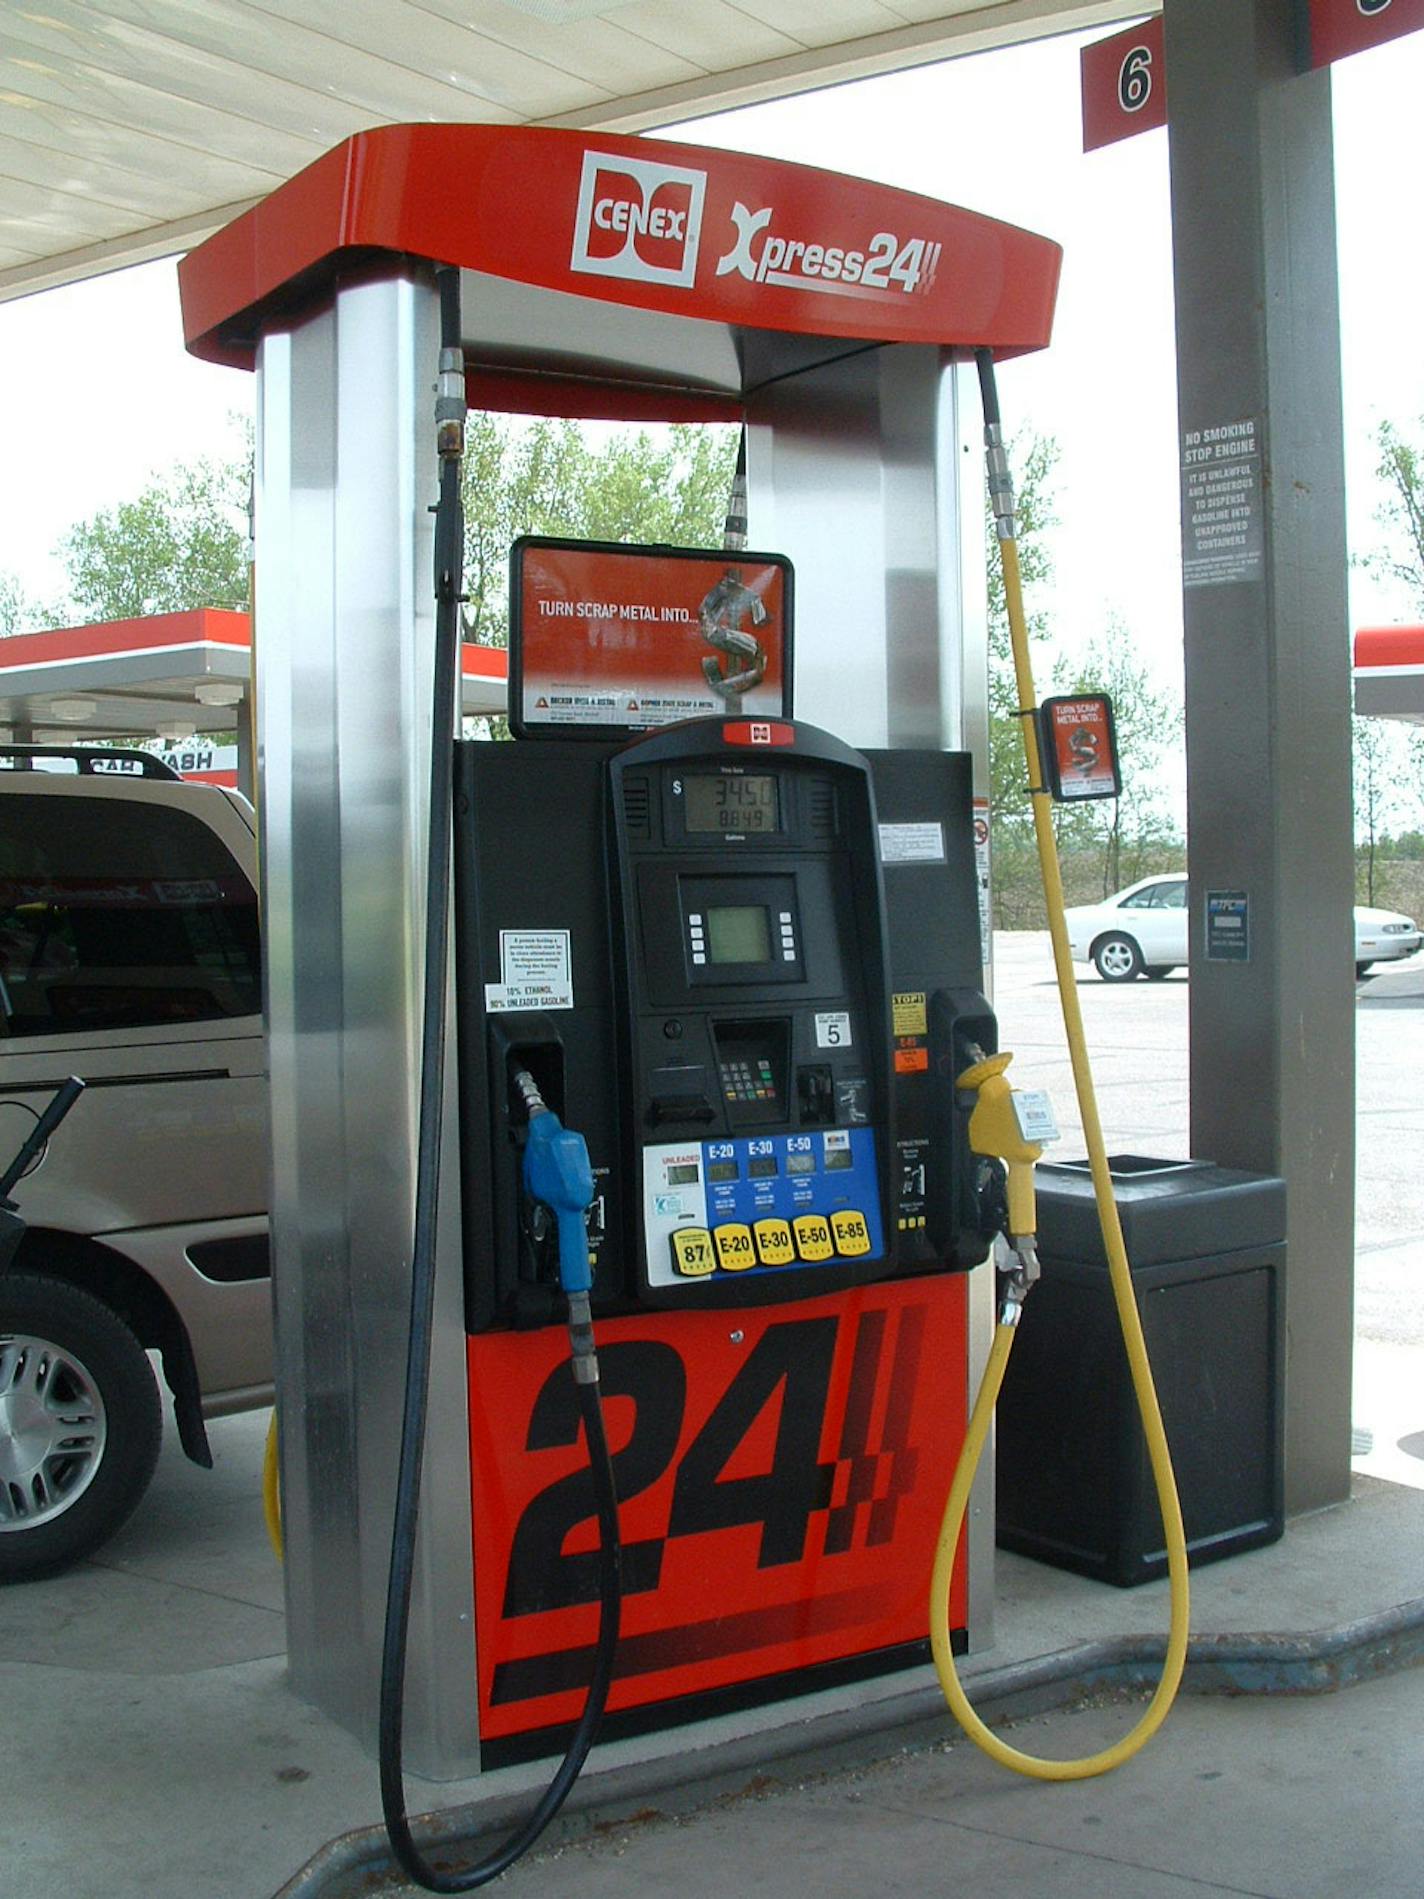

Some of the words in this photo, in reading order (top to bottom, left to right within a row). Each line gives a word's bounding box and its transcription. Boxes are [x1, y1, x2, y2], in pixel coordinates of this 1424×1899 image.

[1118, 46, 1152, 112] 6
[595, 198, 687, 241] CENEX
[1186, 432, 1200, 446] NO
[1203, 422, 1254, 442] SMOKING
[1184, 447, 1212, 463] STOP
[1215, 439, 1255, 458] ENGINE
[1208, 464, 1251, 482] UNLAWFUL
[1206, 478, 1254, 495] DANGEROUS
[539, 600, 574, 617] TURN
[576, 602, 618, 619] SCRAP
[620, 604, 659, 622] METAL
[661, 608, 699, 624] INTO...
[673, 780, 682, 795] $
[828, 1024, 840, 1045] 5
[708, 1144, 734, 1159] E-20
[748, 1140, 773, 1155] E-30
[787, 1137, 811, 1152] E-50
[662, 1155, 700, 1165] UNLEADED
[759, 1231, 788, 1249] E-30
[798, 1227, 827, 1244] E-50
[836, 1222, 864, 1239] E-85
[684, 1244, 705, 1263] 87
[720, 1235, 749, 1253] E-20
[502, 1316, 840, 1619] 24
